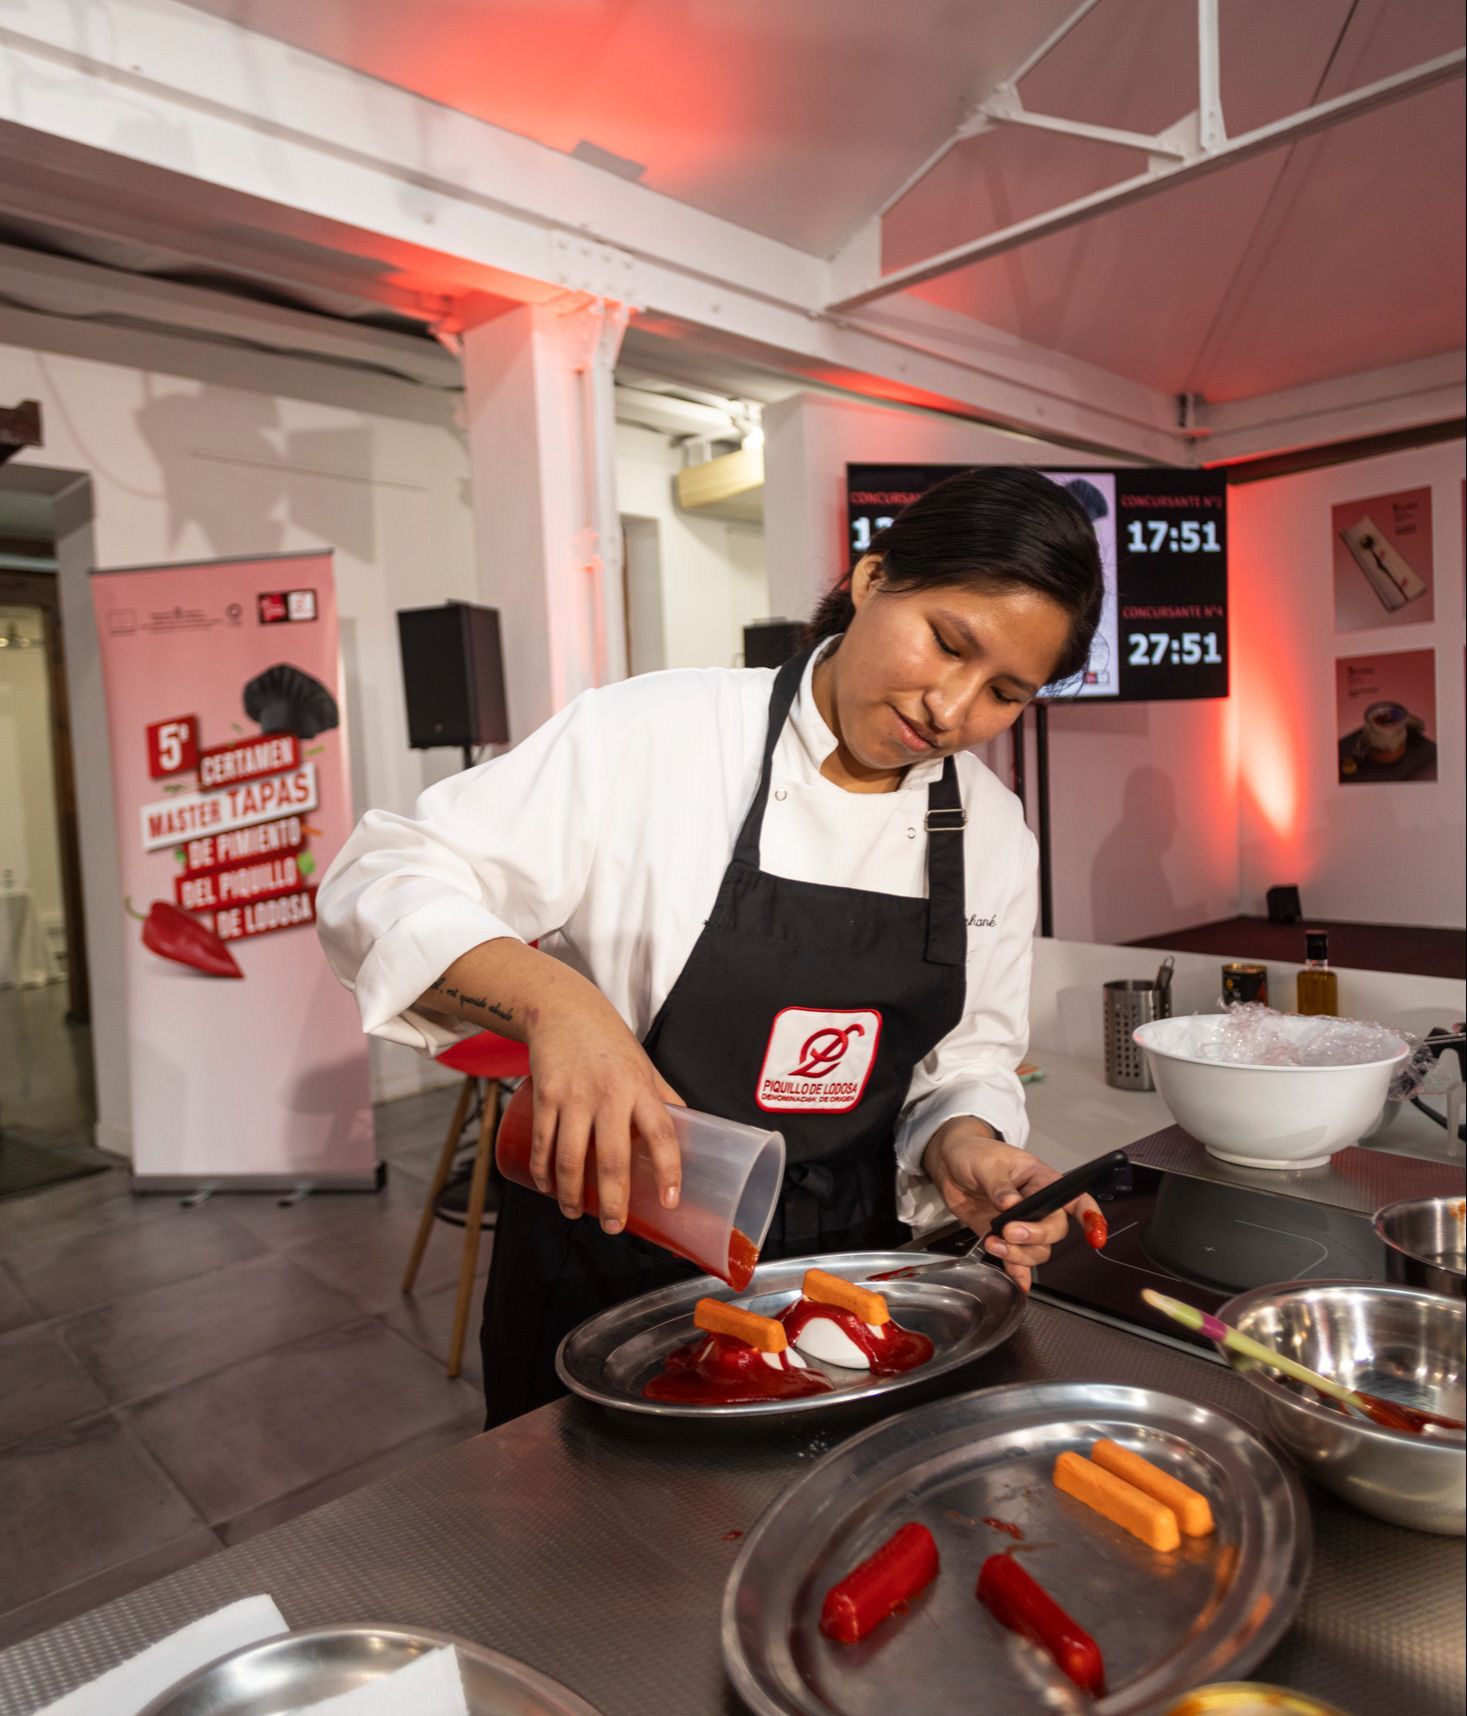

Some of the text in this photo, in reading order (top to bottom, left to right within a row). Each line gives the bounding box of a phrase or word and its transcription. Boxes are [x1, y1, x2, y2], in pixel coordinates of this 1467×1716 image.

[851, 491, 921, 505] CONCURSA
[1121, 494, 1200, 508] CONCURSANTE
[1126, 520, 1221, 553] 17:51
[1122, 605, 1200, 619] CONCURSANTE
[1128, 633, 1222, 665] 27:51
[201, 736, 294, 787] CERTAMEN
[148, 773, 309, 839] MASTER TAPAS
[187, 816, 300, 870] DE PIMIENTO
[181, 857, 298, 910] DEL PIQUILLO
[216, 892, 313, 940] DE LODOSA
[763, 1080, 858, 1095] PIQUILLO DE LODOSA
[829, 1095, 855, 1103] ORIGEN
